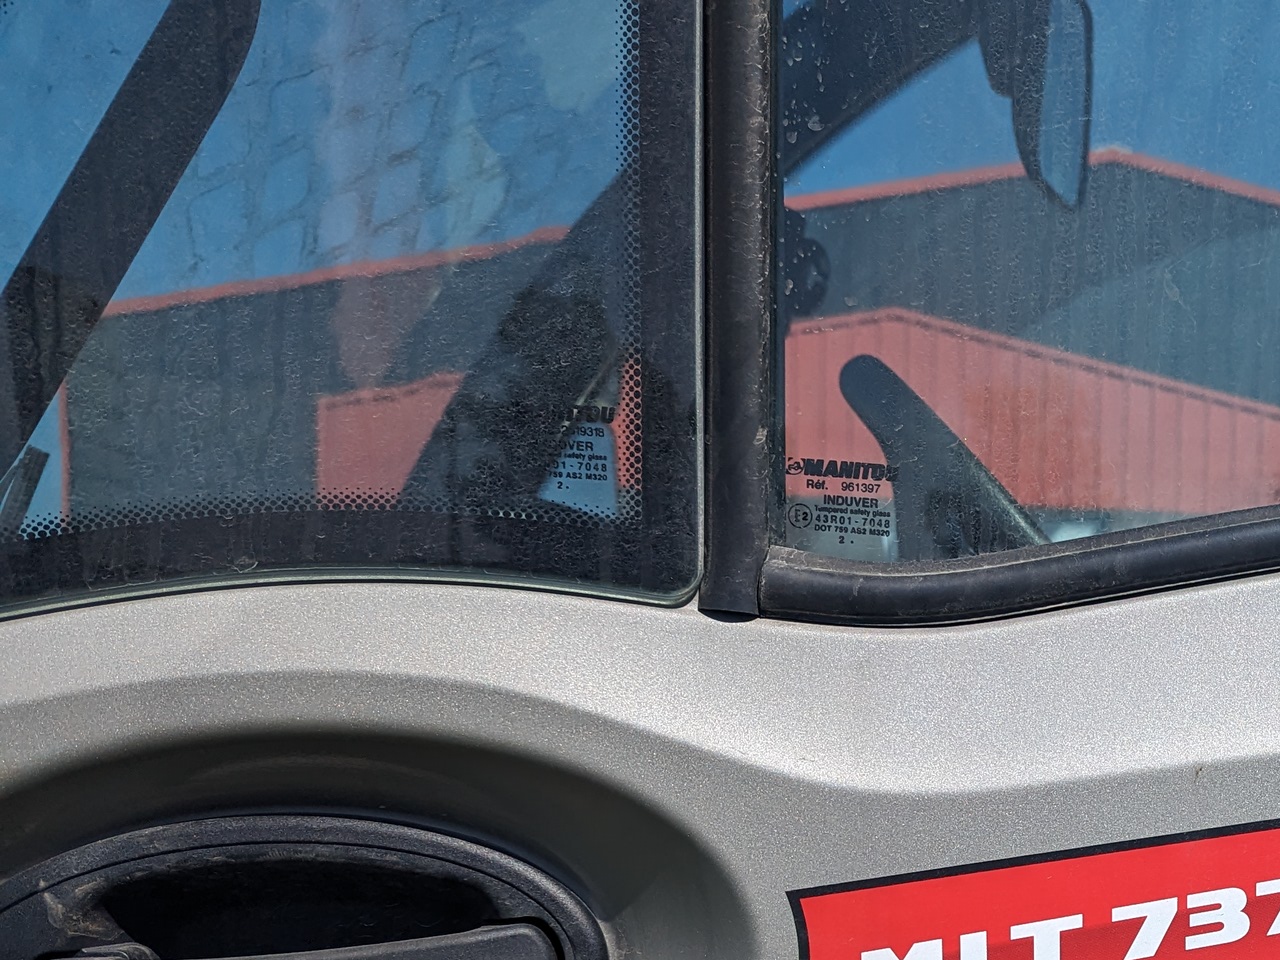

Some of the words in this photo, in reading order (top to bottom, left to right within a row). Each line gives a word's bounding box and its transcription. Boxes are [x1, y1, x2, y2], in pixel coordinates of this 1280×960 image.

[565, 472, 582, 480] AS2
[585, 473, 608, 481] M320
[806, 479, 828, 490] Réf.
[841, 482, 881, 493] 961397
[823, 494, 879, 508] INDUVER
[849, 508, 871, 517] safety
[872, 509, 891, 518] glass
[814, 523, 832, 532] DOT
[834, 525, 849, 533] 759
[850, 527, 867, 535] AS2
